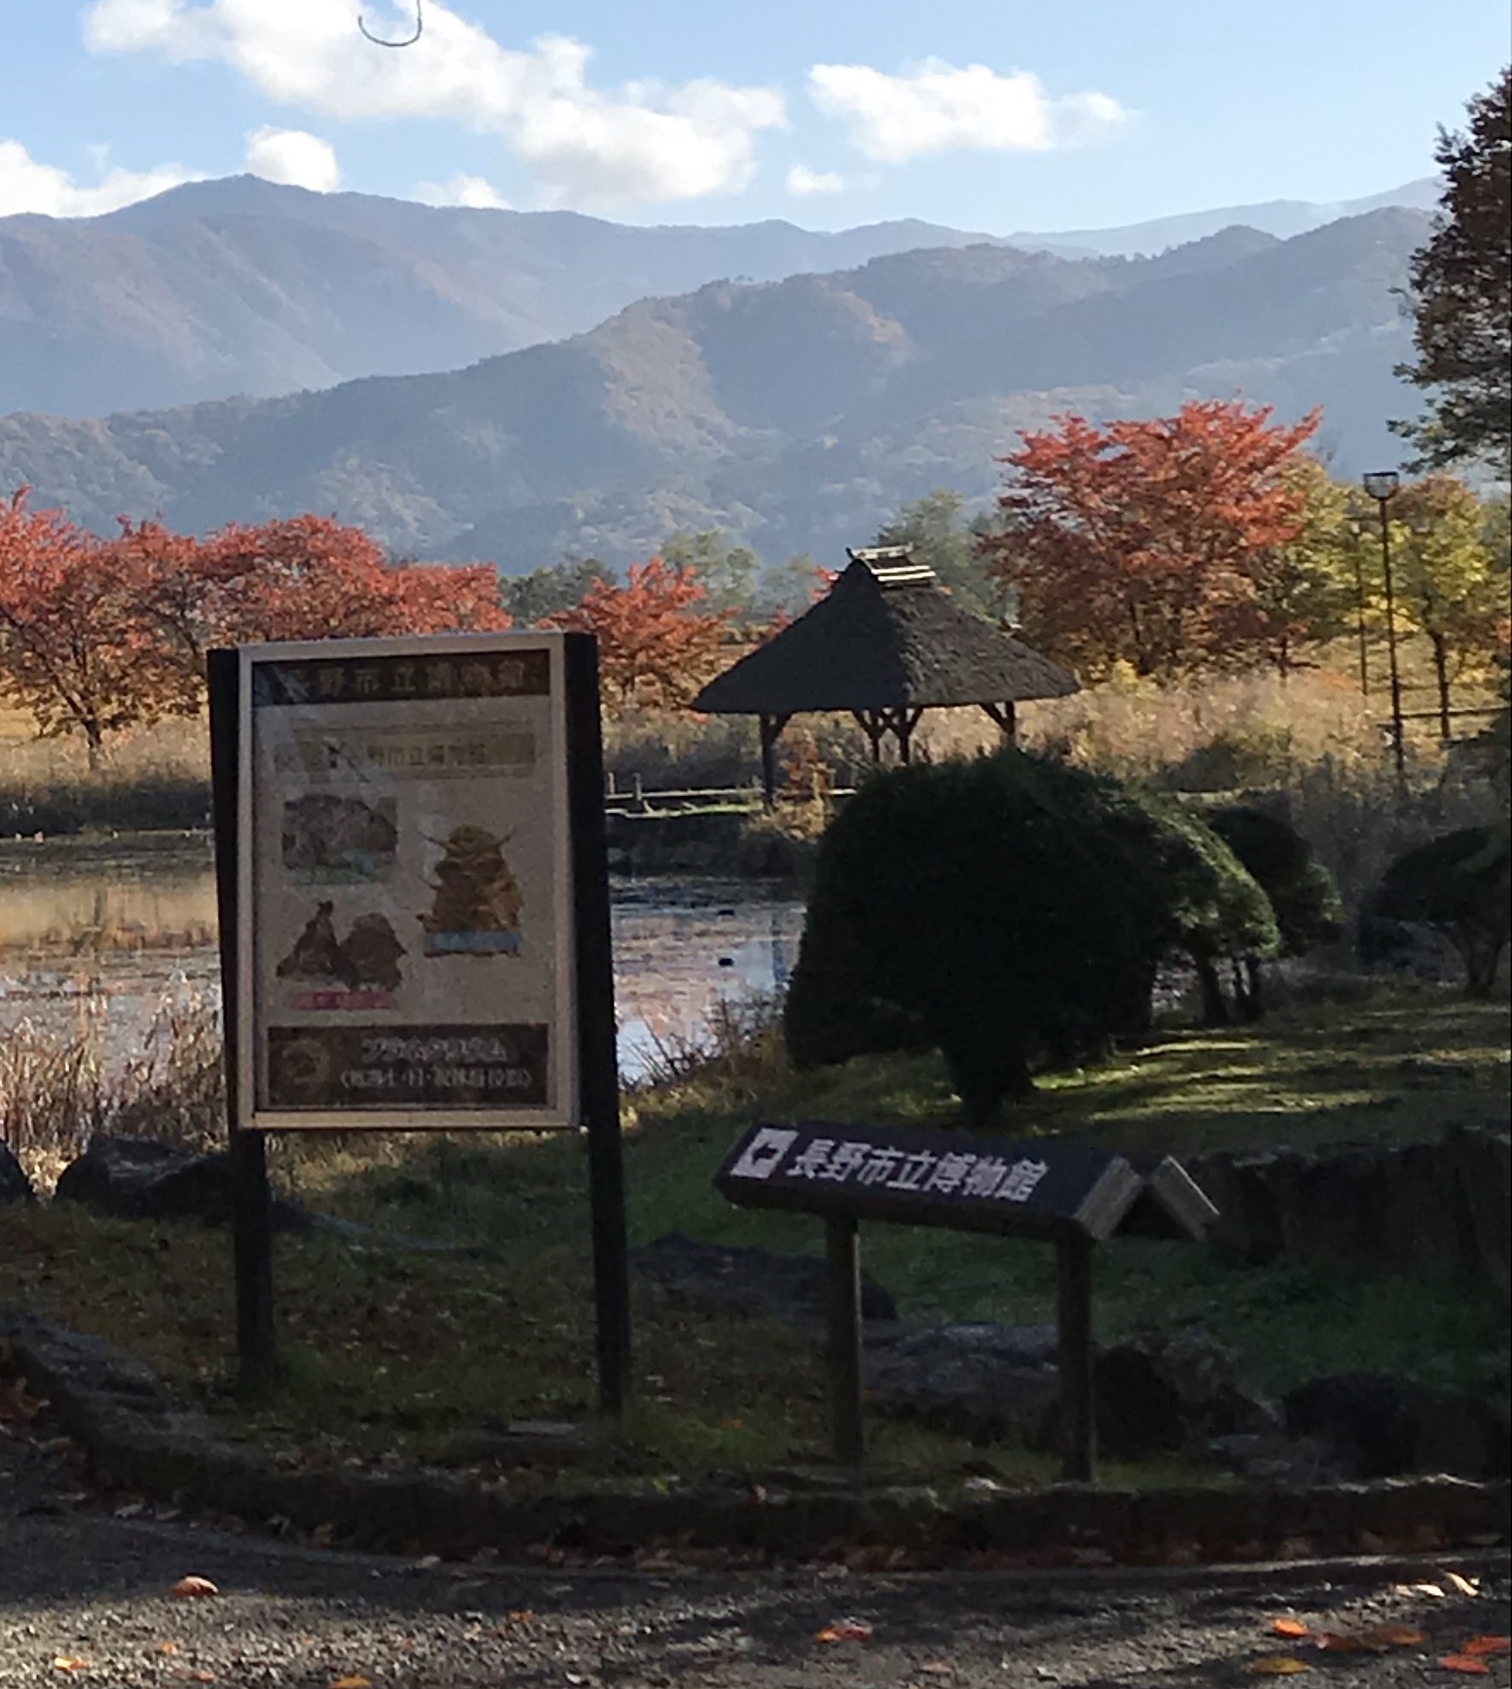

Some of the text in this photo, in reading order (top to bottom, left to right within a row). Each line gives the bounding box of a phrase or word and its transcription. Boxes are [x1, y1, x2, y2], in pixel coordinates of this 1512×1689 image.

[787, 1139, 1049, 1202] 長野市立博物館
